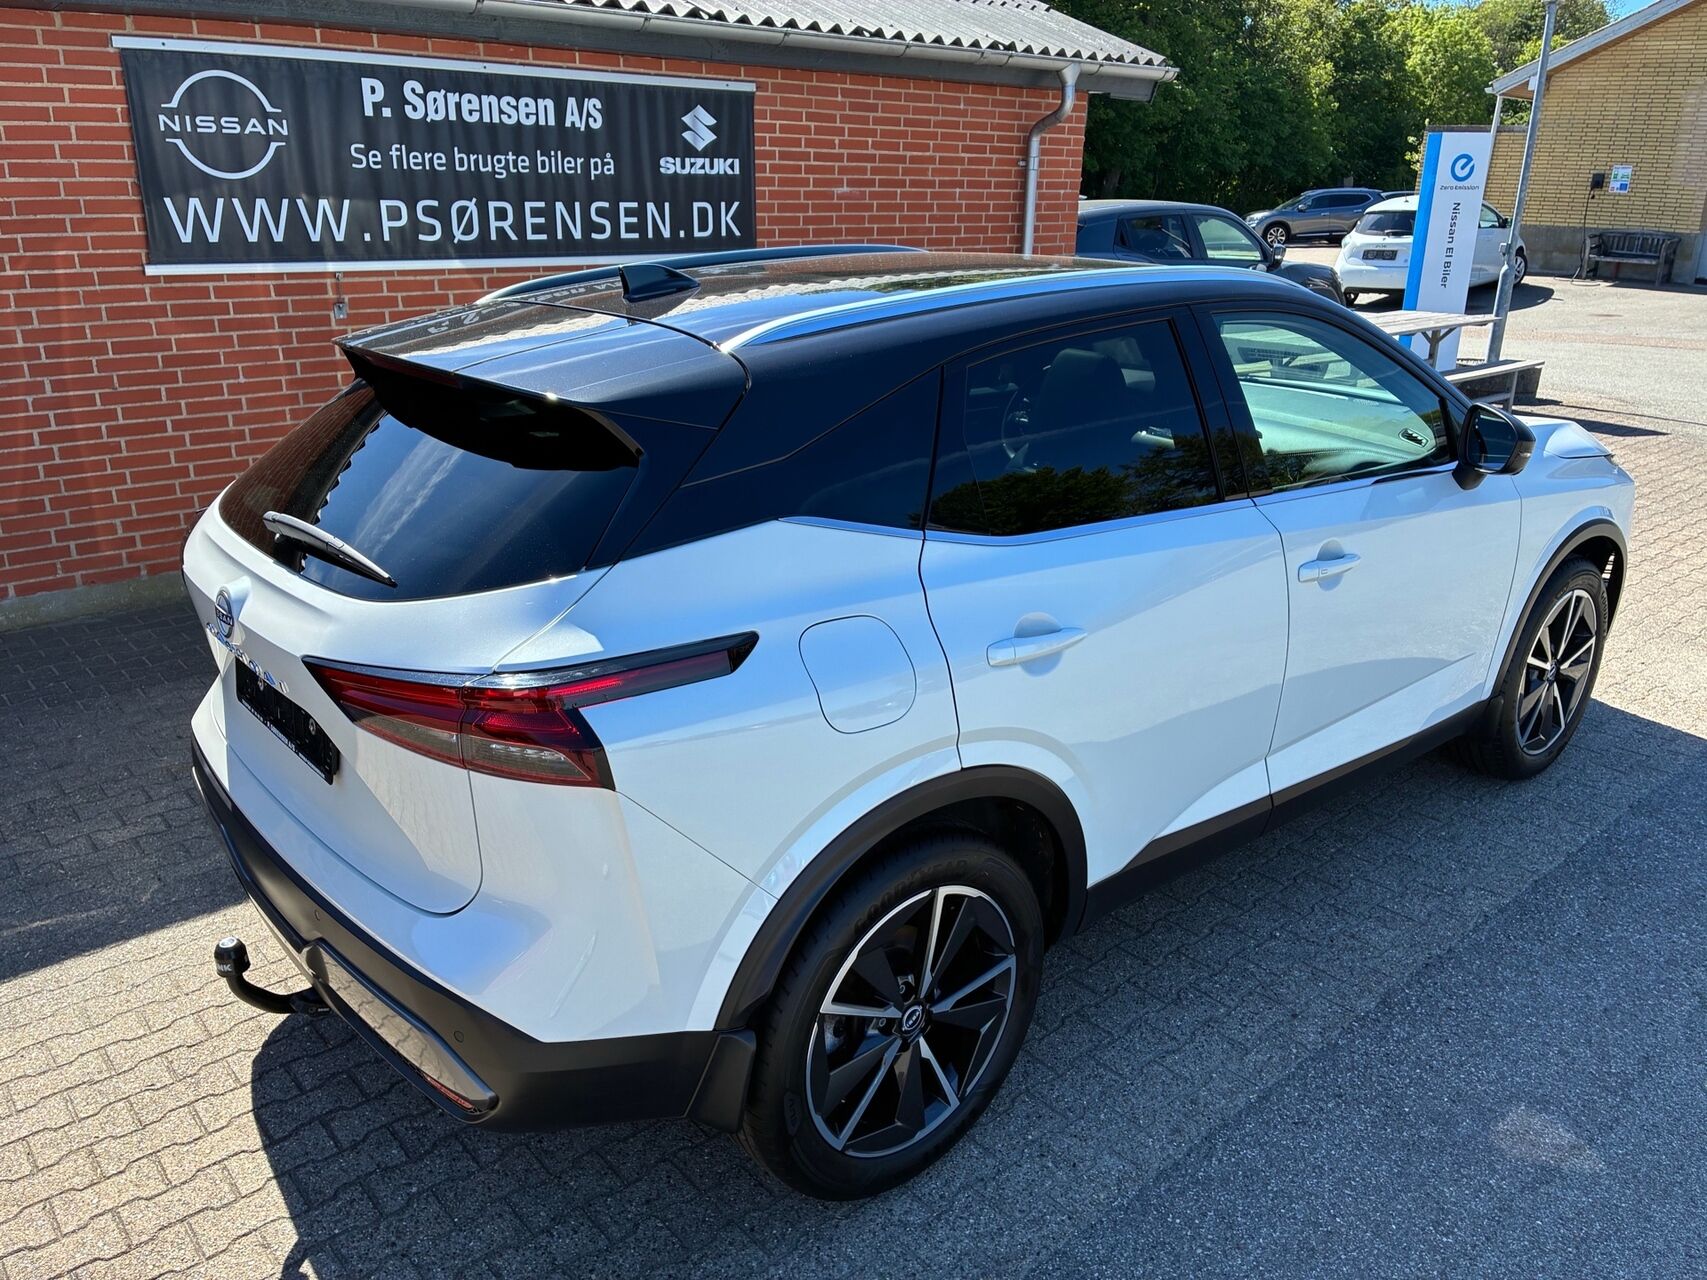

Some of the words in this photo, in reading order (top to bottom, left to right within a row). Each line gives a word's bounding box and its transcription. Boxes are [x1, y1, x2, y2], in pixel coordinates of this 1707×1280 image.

[360, 77, 392, 117] P.
[403, 80, 556, 126] Sørensen
[564, 95, 603, 130] A/S
[158, 113, 289, 136] NISSAN
[350, 143, 382, 170] Se
[388, 144, 447, 172] flere
[454, 147, 530, 180] brugte
[536, 150, 584, 175] biler
[590, 152, 616, 180] på
[659, 156, 740, 176] SUZUKI
[163, 197, 742, 243] WWW.PSØRENSEN.DK
[1447, 202, 1461, 243] Nissan
[1440, 261, 1453, 288] Biler
